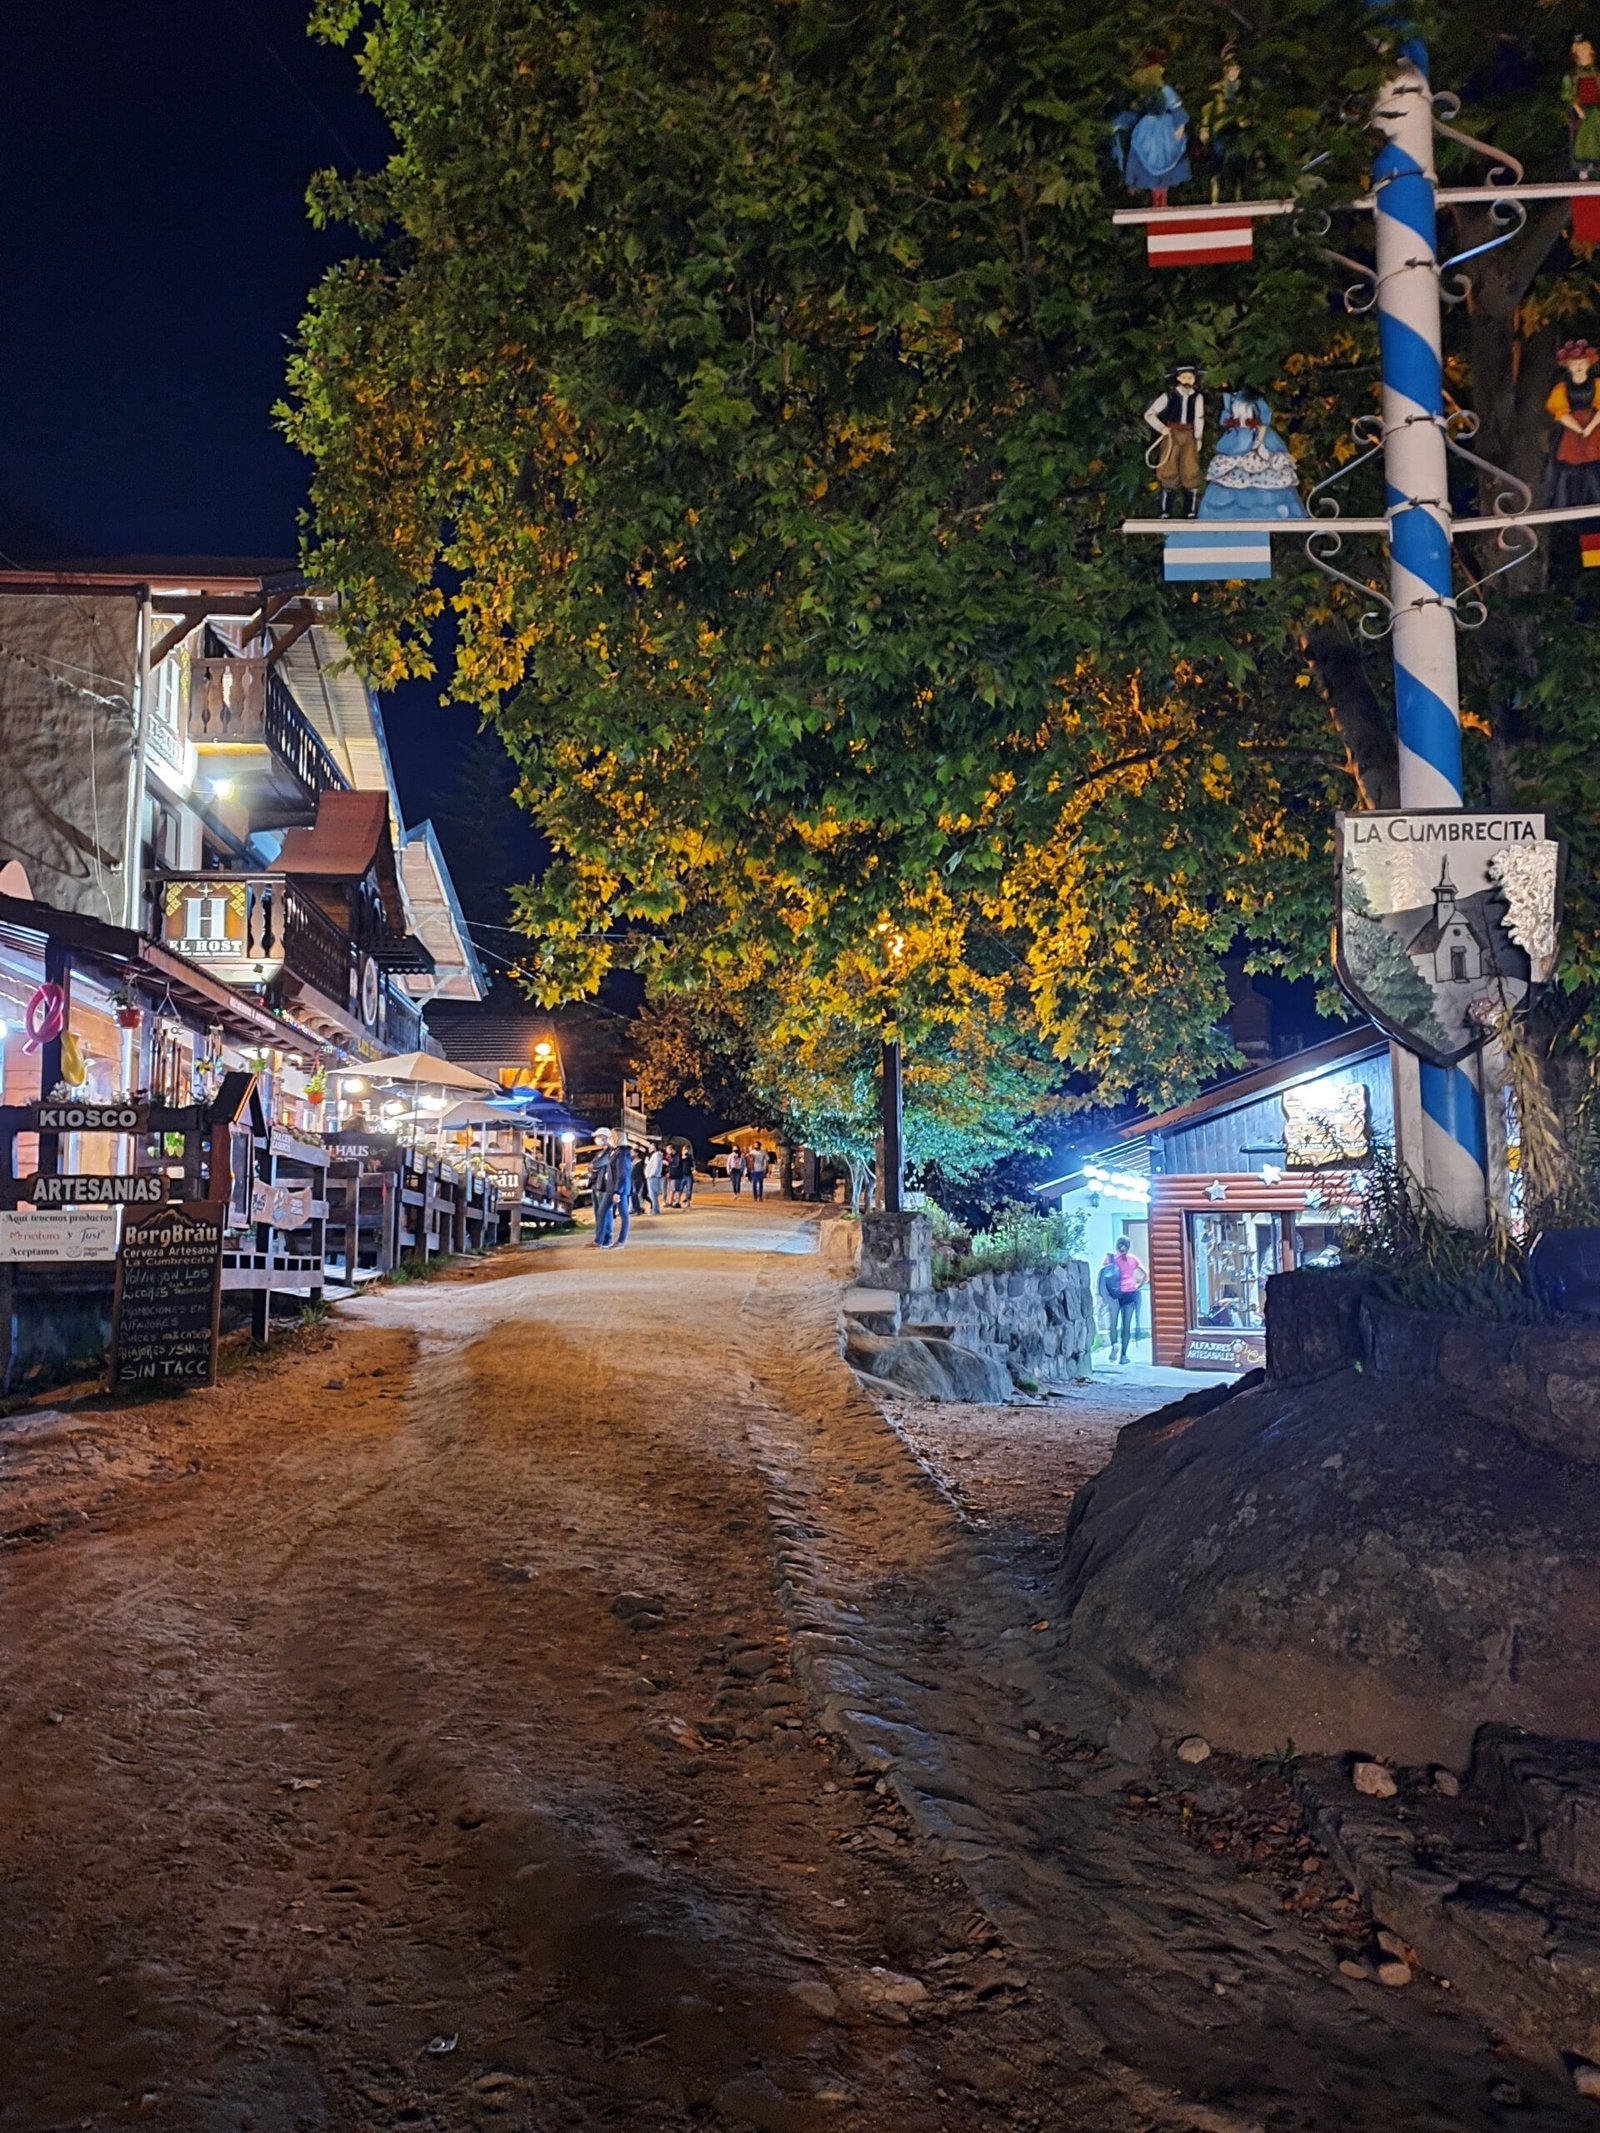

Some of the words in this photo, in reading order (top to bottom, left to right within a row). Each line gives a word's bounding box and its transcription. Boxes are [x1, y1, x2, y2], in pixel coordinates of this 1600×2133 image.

[1353, 822, 1382, 843] LA
[196, 940, 242, 952] HOST
[40, 1109, 137, 1127] KIOSCO
[33, 1178, 161, 1201] ARTESANIAS
[31, 1214, 67, 1222] tenemos
[69, 1214, 113, 1224] productos
[126, 1223, 217, 1248] BergBräu
[10, 1247, 59, 1258] Aceptamos
[123, 1248, 164, 1258] Cerveza
[169, 1245, 217, 1256] Artesanal
[126, 1259, 140, 1267] La
[146, 1256, 214, 1266] Cumbrecita
[120, 1363, 155, 1380] SIN
[160, 1360, 207, 1375] TACC
